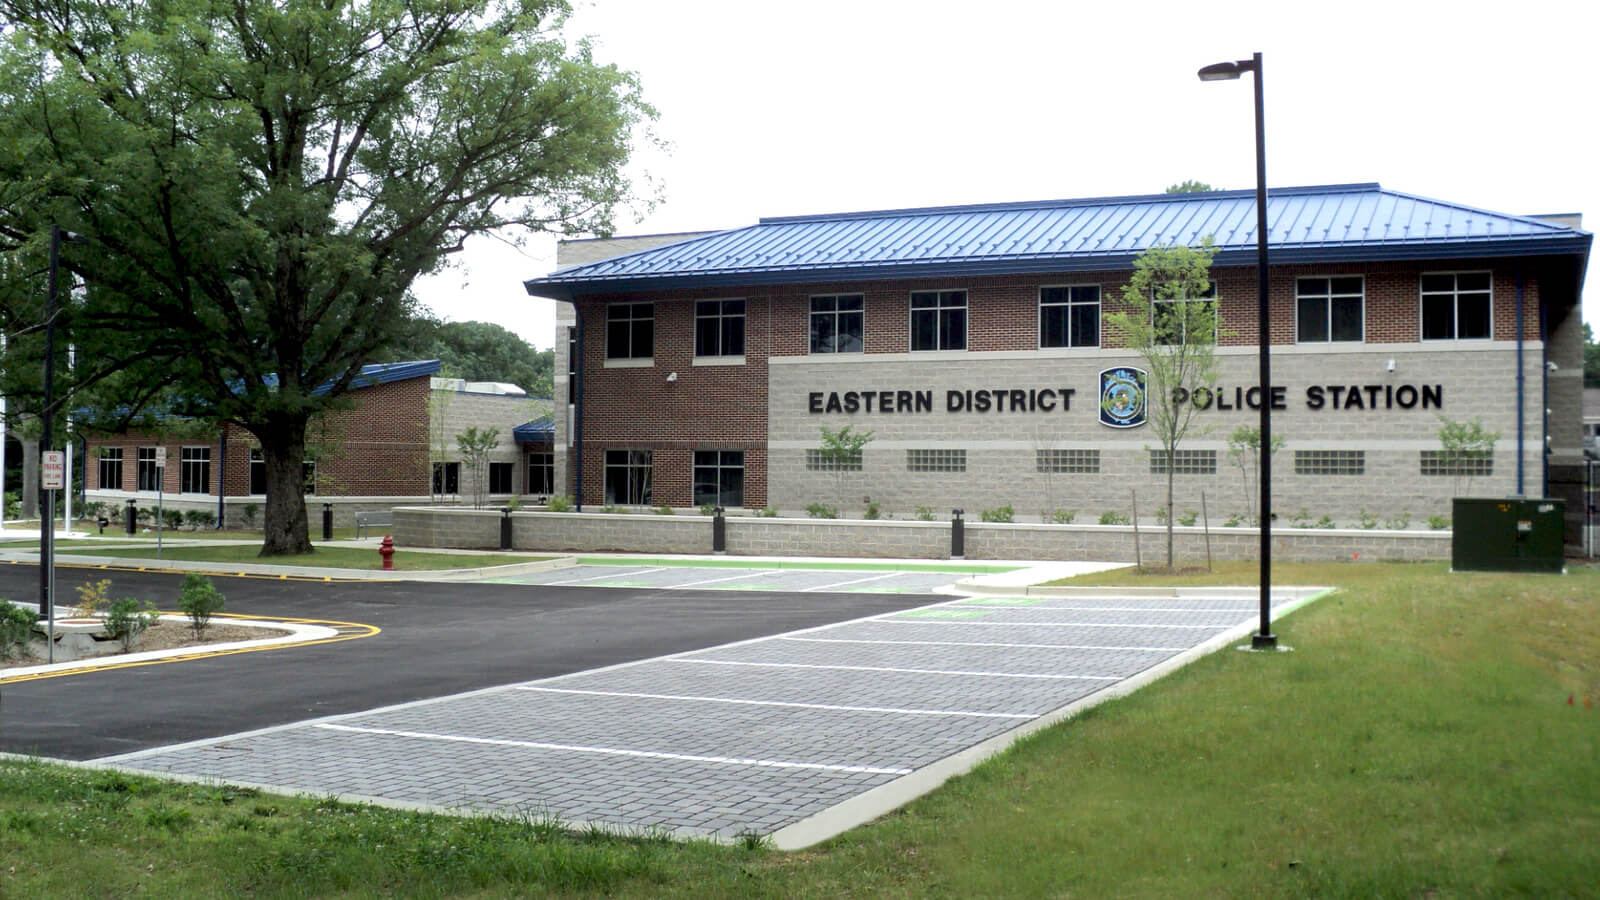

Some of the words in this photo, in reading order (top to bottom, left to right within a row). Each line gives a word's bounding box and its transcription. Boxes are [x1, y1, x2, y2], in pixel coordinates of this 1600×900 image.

[809, 391, 932, 413] EASTERN
[947, 389, 1076, 412] DISTRICT
[1172, 386, 1287, 410] POLICE
[1306, 384, 1442, 410] STATION
